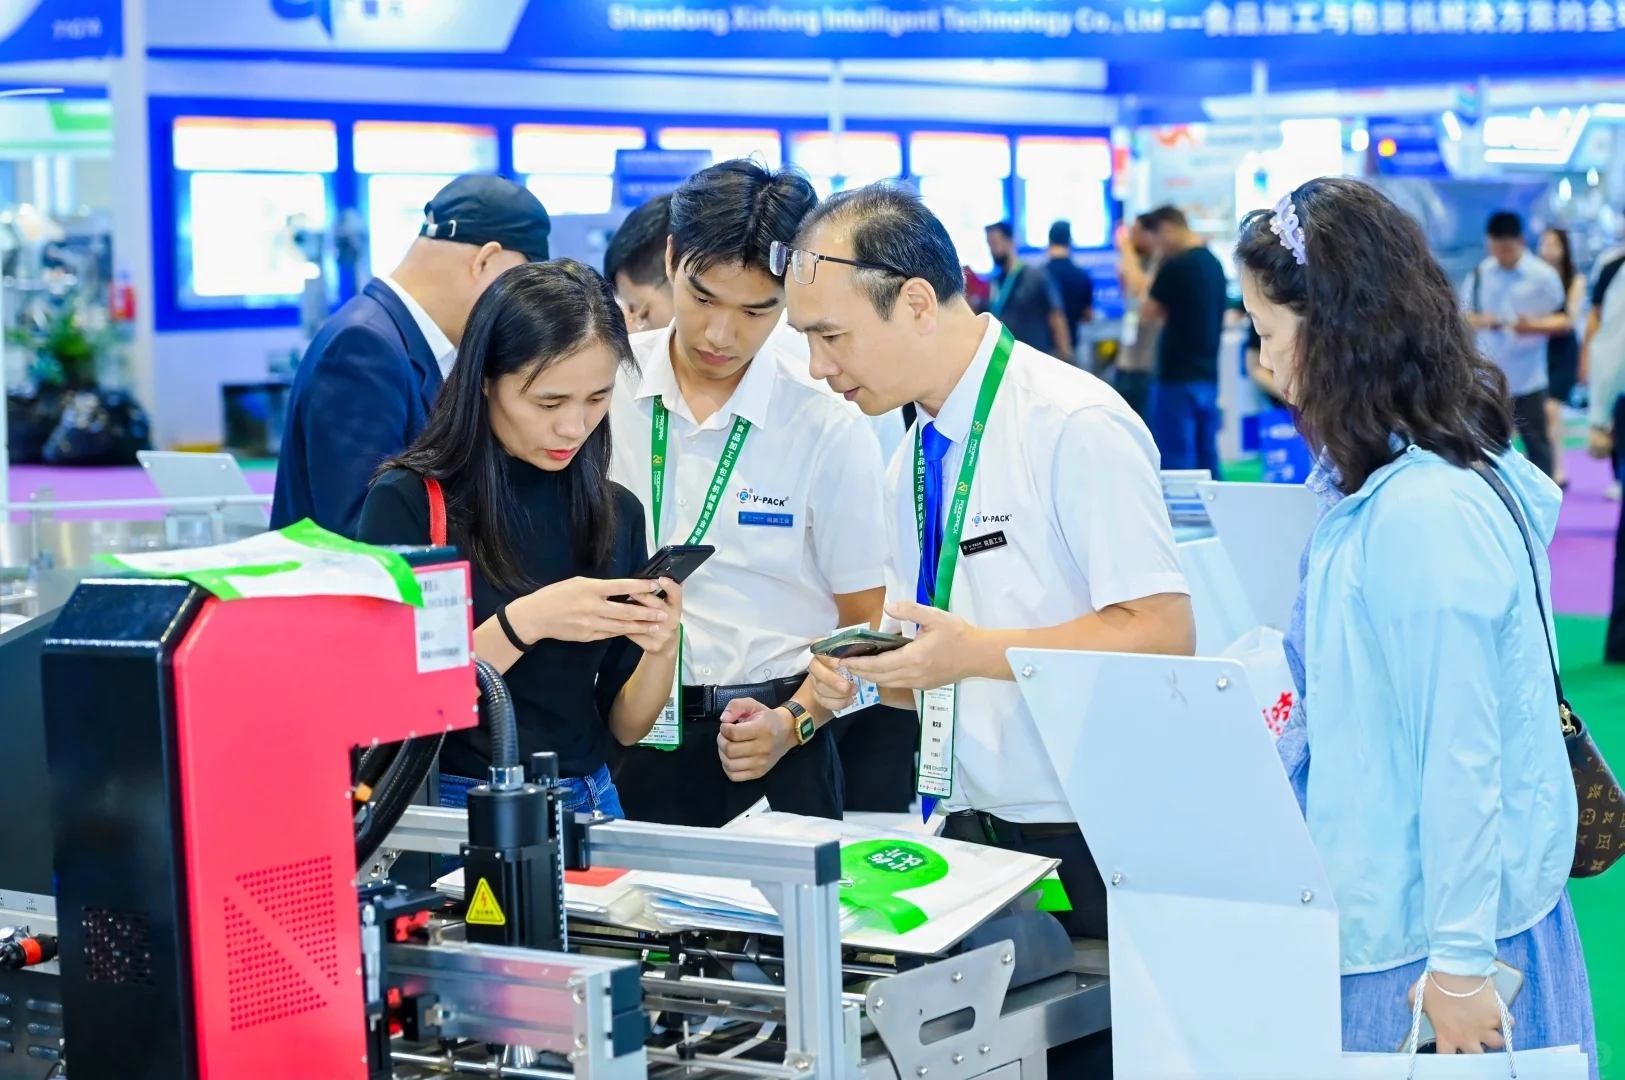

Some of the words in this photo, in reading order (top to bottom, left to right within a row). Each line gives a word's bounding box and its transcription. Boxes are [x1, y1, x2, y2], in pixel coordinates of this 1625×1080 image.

[608, 5, 729, 36] Shandong
[823, 6, 940, 37] Intelligent
[944, 7, 1072, 37] Technology
